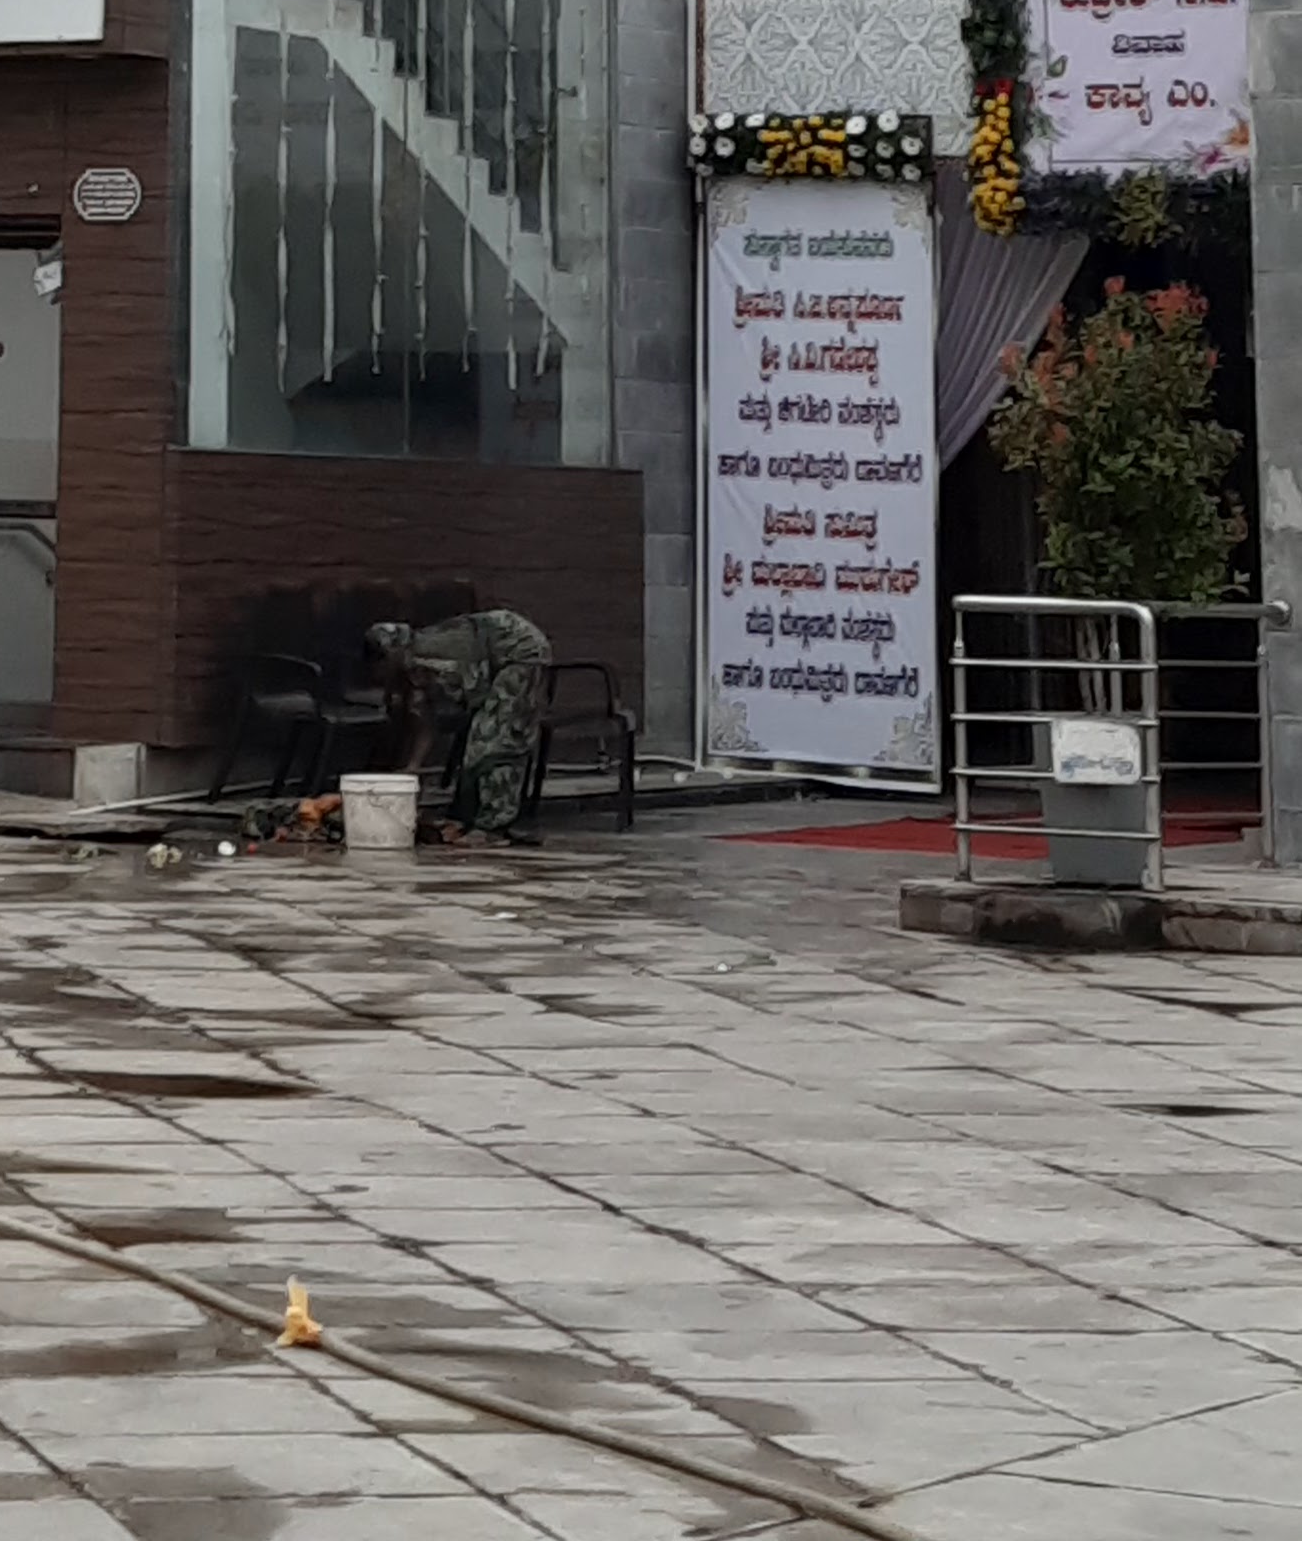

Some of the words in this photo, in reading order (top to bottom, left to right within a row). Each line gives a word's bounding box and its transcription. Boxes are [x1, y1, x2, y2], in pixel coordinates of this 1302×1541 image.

[1085, 77, 1153, 126] ಕಾವ್ಯ
[734, 285, 784, 328] ಶ್ರೀಮತಿ
[759, 336, 780, 381] ಶ್ರೀ
[739, 390, 772, 433] ಮತ್ತು
[718, 448, 760, 477] ಹಾಗೂ
[856, 452, 922, 482] ದಾವಣಗೆರೆ
[762, 503, 816, 546] ಶ್ರೀಮತಿ
[722, 553, 743, 597] ಶ್ರೀ
[746, 605, 774, 648] ಮತ್ತು
